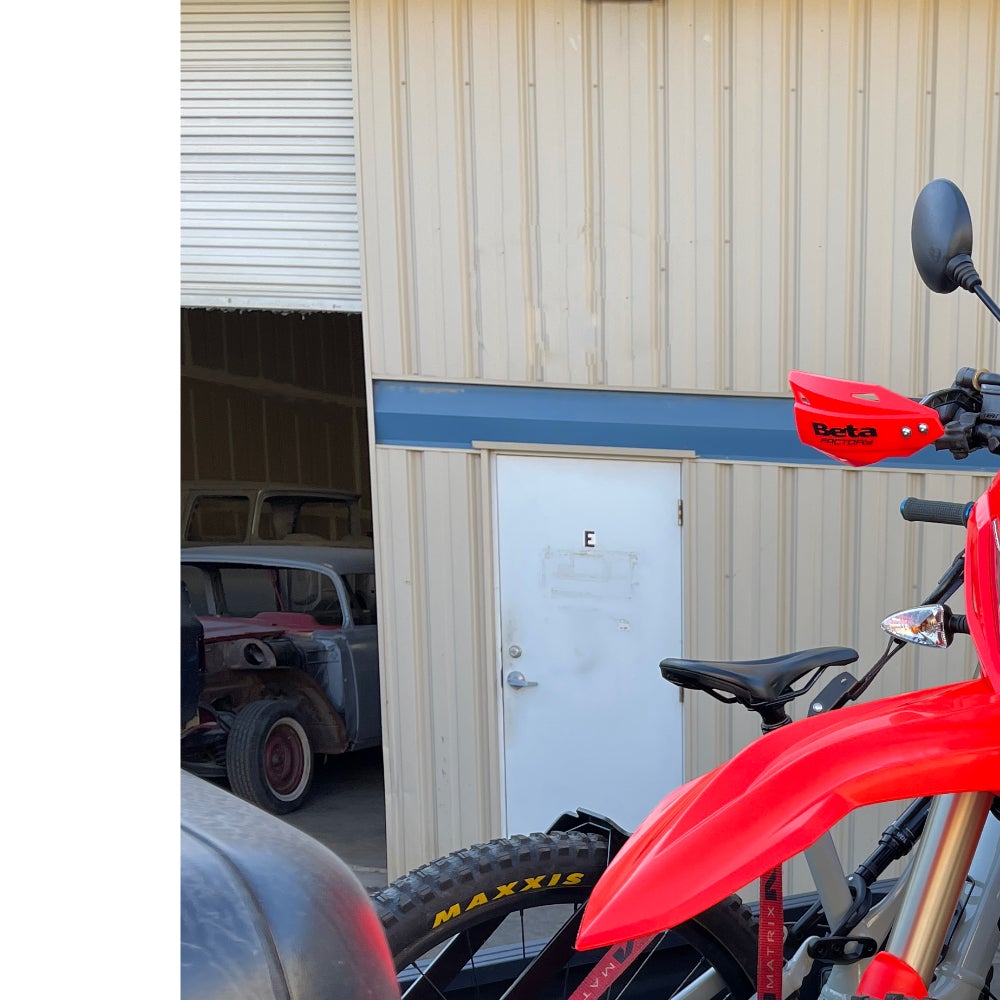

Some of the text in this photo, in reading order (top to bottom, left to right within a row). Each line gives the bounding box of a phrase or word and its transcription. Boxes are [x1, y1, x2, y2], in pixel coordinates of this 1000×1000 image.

[812, 422, 877, 438] Beta
[584, 530, 595, 548] E
[432, 871, 585, 929] MAXXIS
[766, 906, 775, 989] MATRIX
